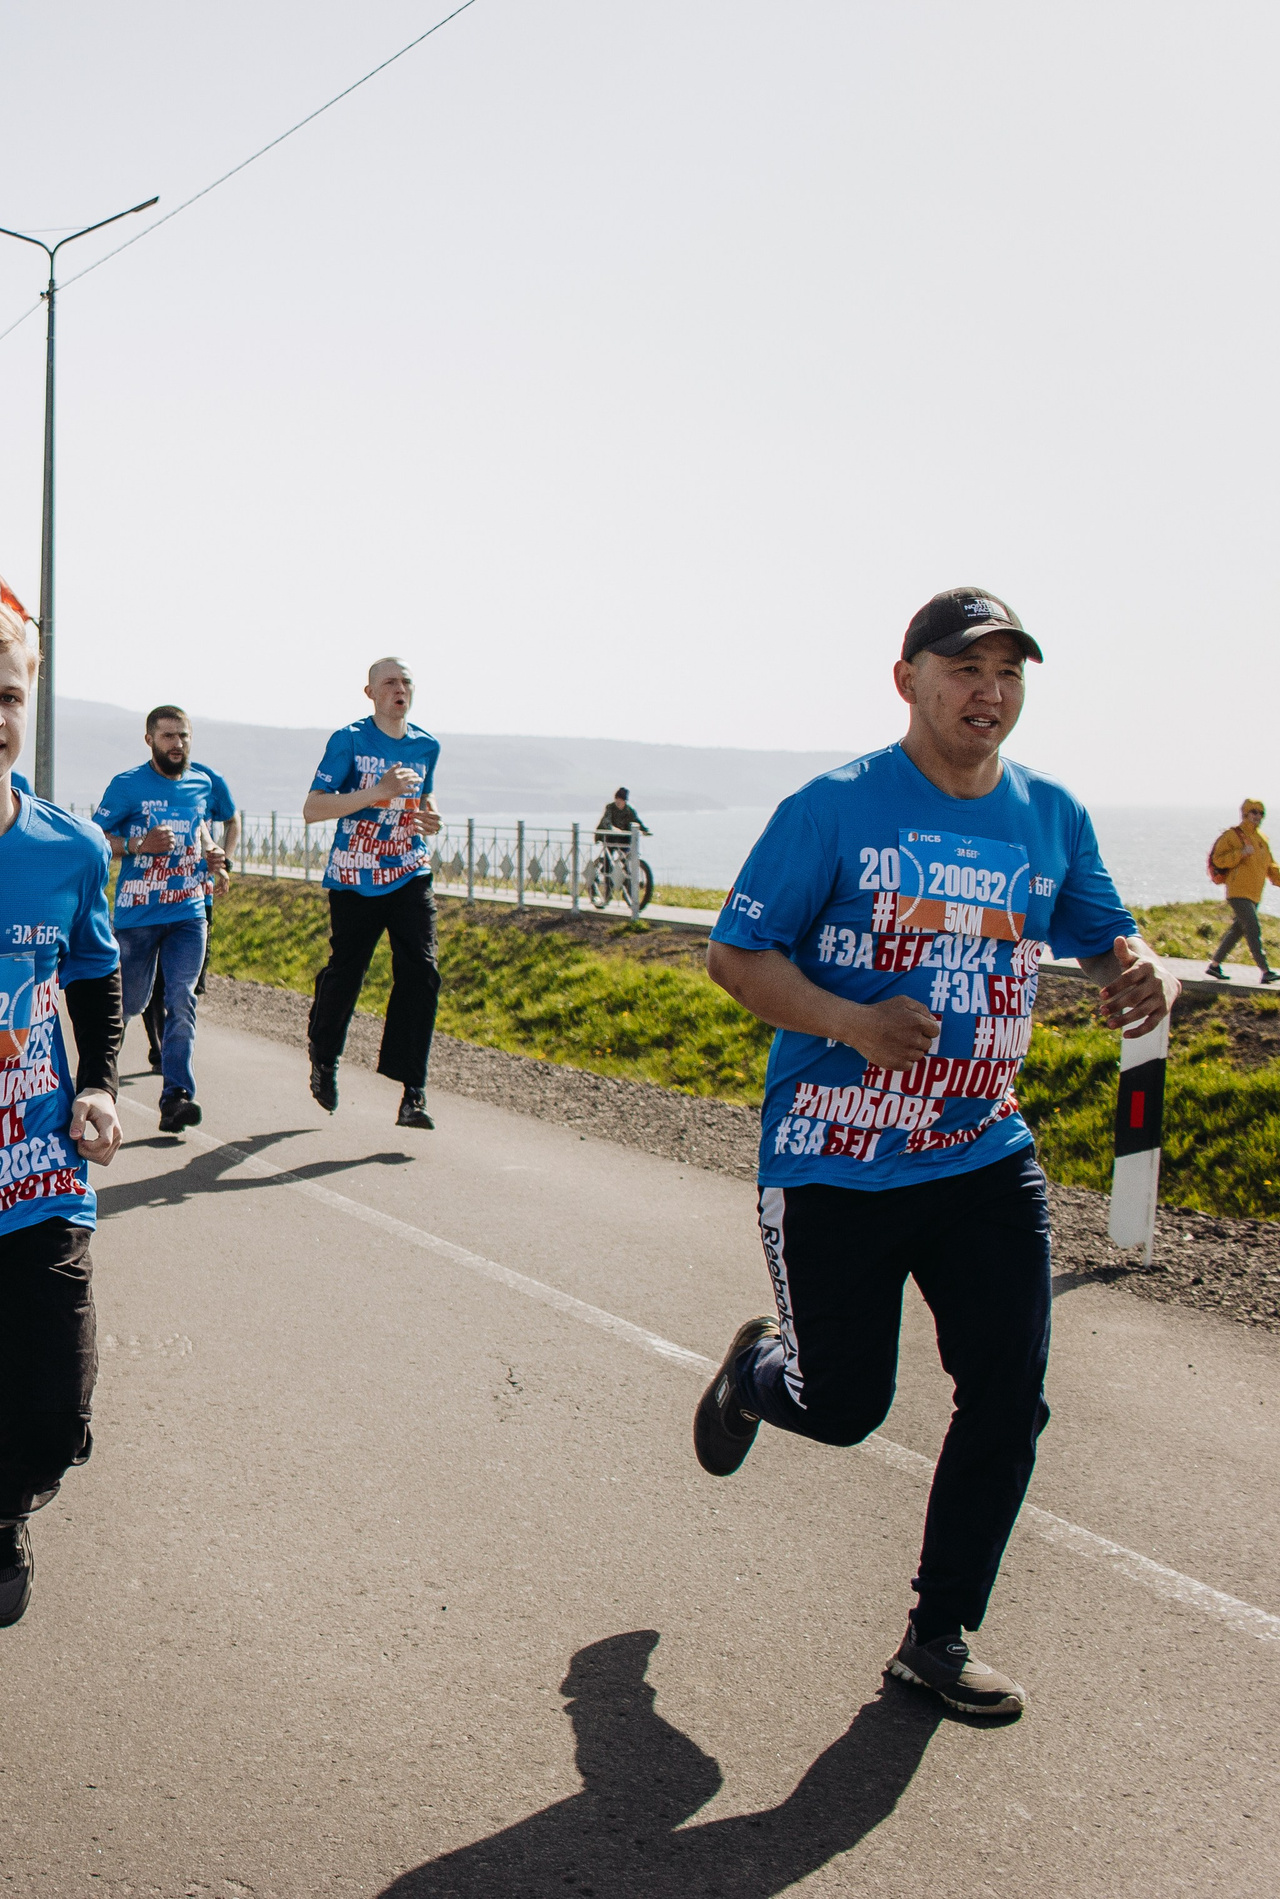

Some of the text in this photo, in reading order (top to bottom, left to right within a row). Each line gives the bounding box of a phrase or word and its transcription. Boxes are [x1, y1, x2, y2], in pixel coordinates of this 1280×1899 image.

[920, 834, 942, 843] ПСБ
[858, 847, 900, 891] 20
[928, 861, 1007, 905] 20032
[943, 901, 985, 937] 5КМ
[817, 924, 935, 973] #ЗАБЕГ
[921, 933, 998, 973] 2024
[788, 1081, 946, 1132] #ЛЮБОВЬ
[774, 1116, 882, 1163] #ЗАБЕГ
[762, 1223, 794, 1333] Reebok
